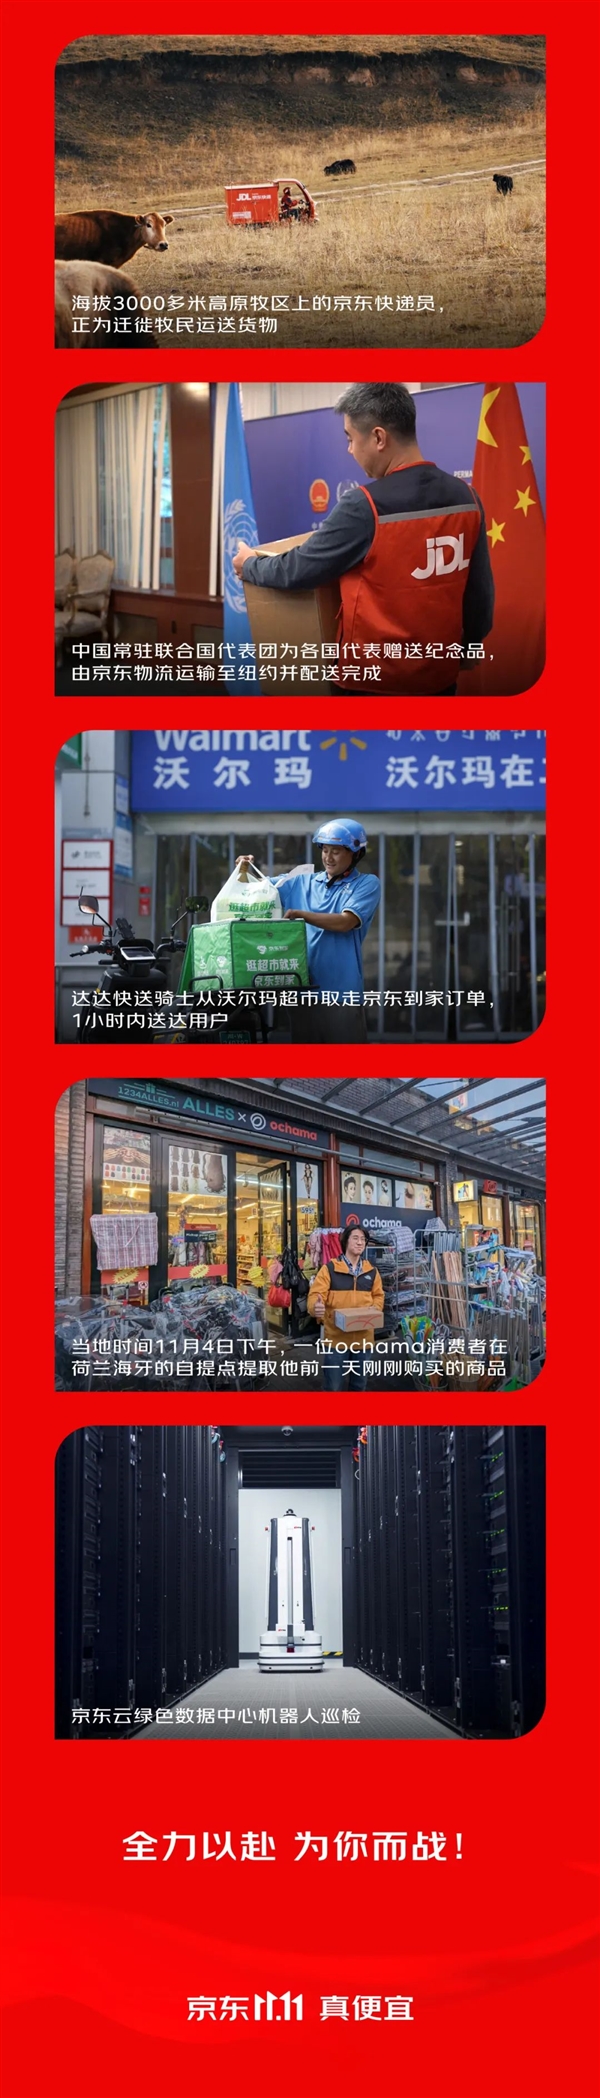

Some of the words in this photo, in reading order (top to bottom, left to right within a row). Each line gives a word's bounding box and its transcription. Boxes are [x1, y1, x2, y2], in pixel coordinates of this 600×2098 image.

[236, 193, 252, 201] JDL
[411, 532, 470, 580] JDL
[154, 730, 312, 751] Walmart
[153, 756, 312, 790] 沃尔玛
[246, 958, 300, 972] 逛超市就来
[118, 1086, 179, 1108] 1234ALLES.nl
[182, 1096, 235, 1121] ALLES
[270, 1120, 318, 1141] ochama
[362, 1216, 402, 1228] ochama
